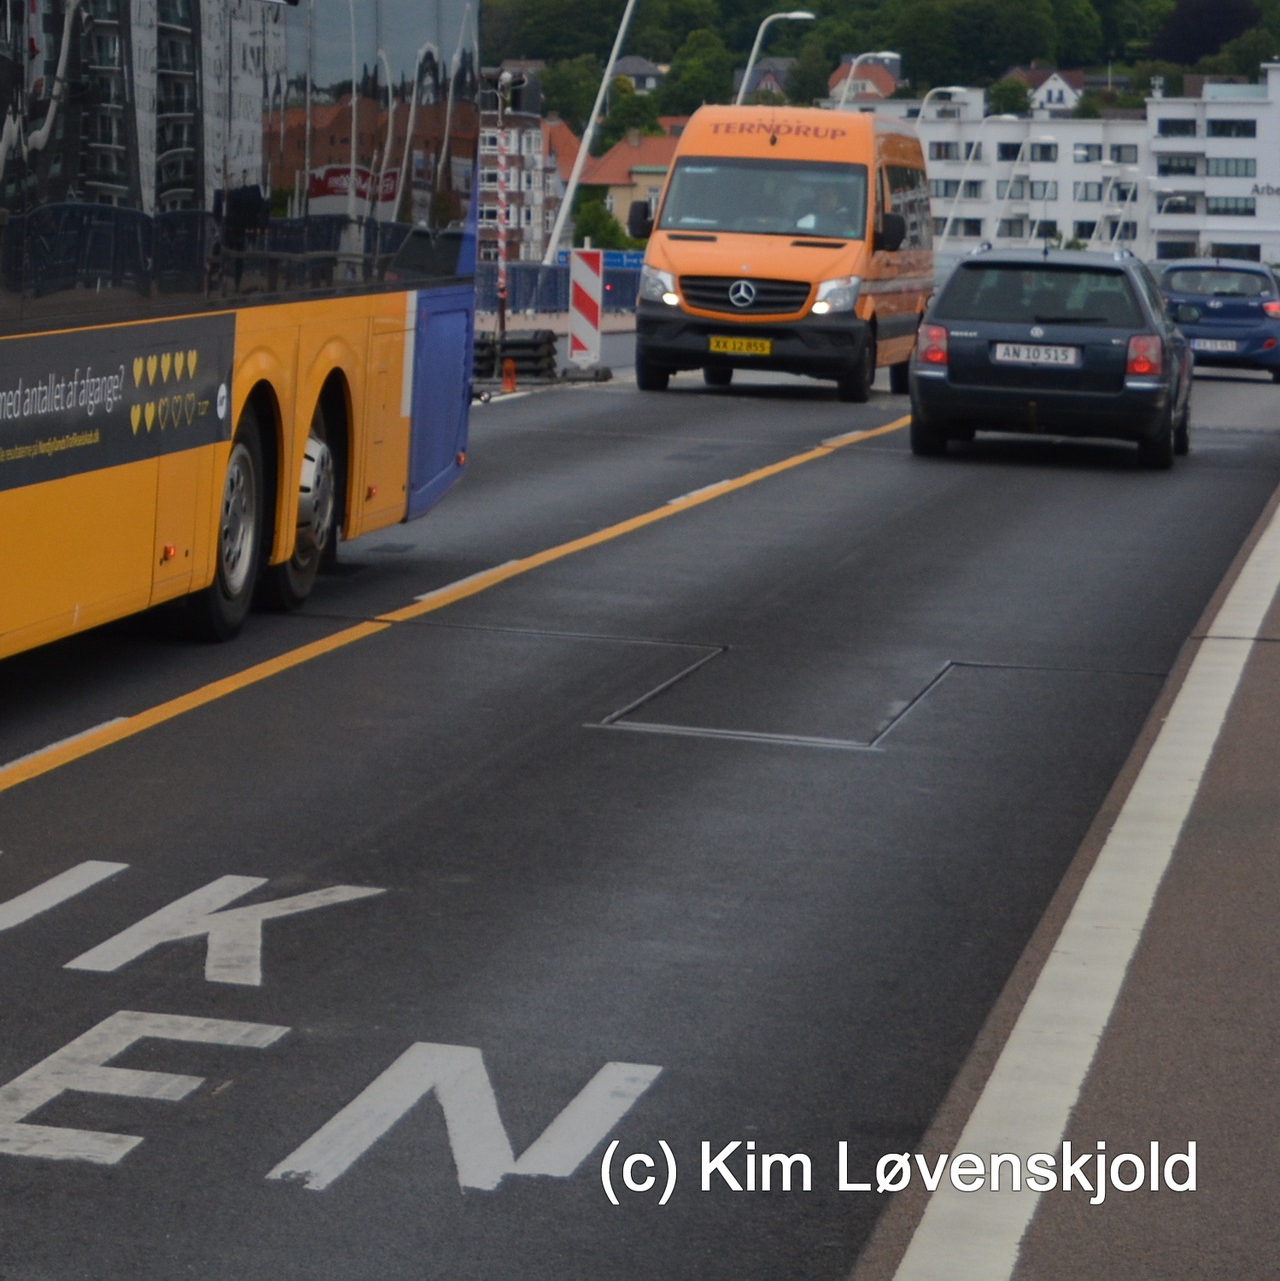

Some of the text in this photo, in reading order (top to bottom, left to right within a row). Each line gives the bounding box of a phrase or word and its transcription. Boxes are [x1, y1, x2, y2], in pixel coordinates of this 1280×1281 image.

[711, 122, 847, 140] TERNDRUP
[1002, 347, 1069, 362] AN 10 515
[23, 373, 65, 417] antallet
[66, 368, 80, 410] af
[79, 365, 125, 416] afgange?
